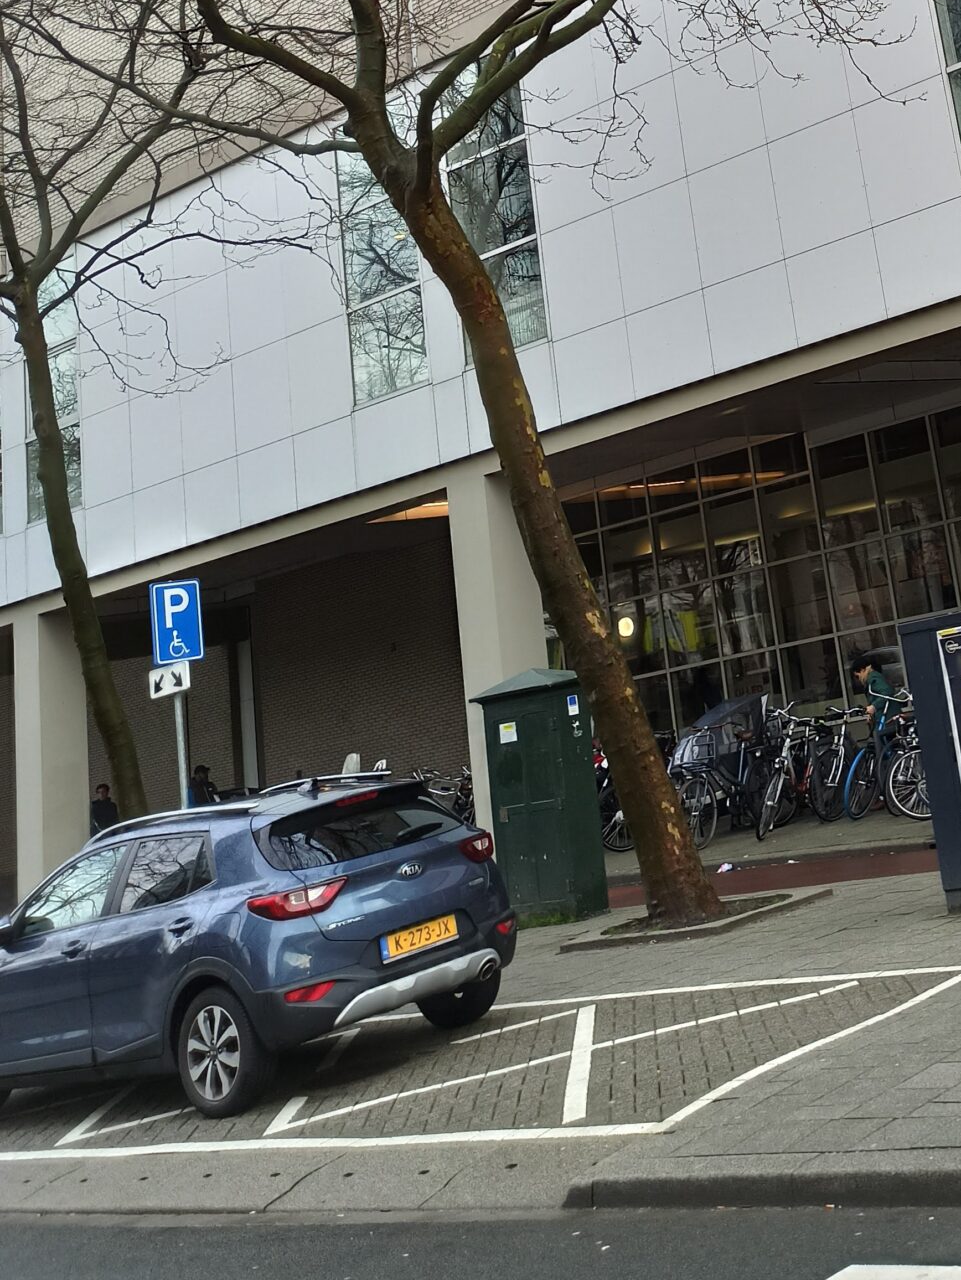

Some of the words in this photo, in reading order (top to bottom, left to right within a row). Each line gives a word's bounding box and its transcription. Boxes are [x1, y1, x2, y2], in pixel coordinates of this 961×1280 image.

[163, 587, 189, 629] P
[406, 864, 421, 877] KIA
[393, 919, 451, 952] K-273-JX
